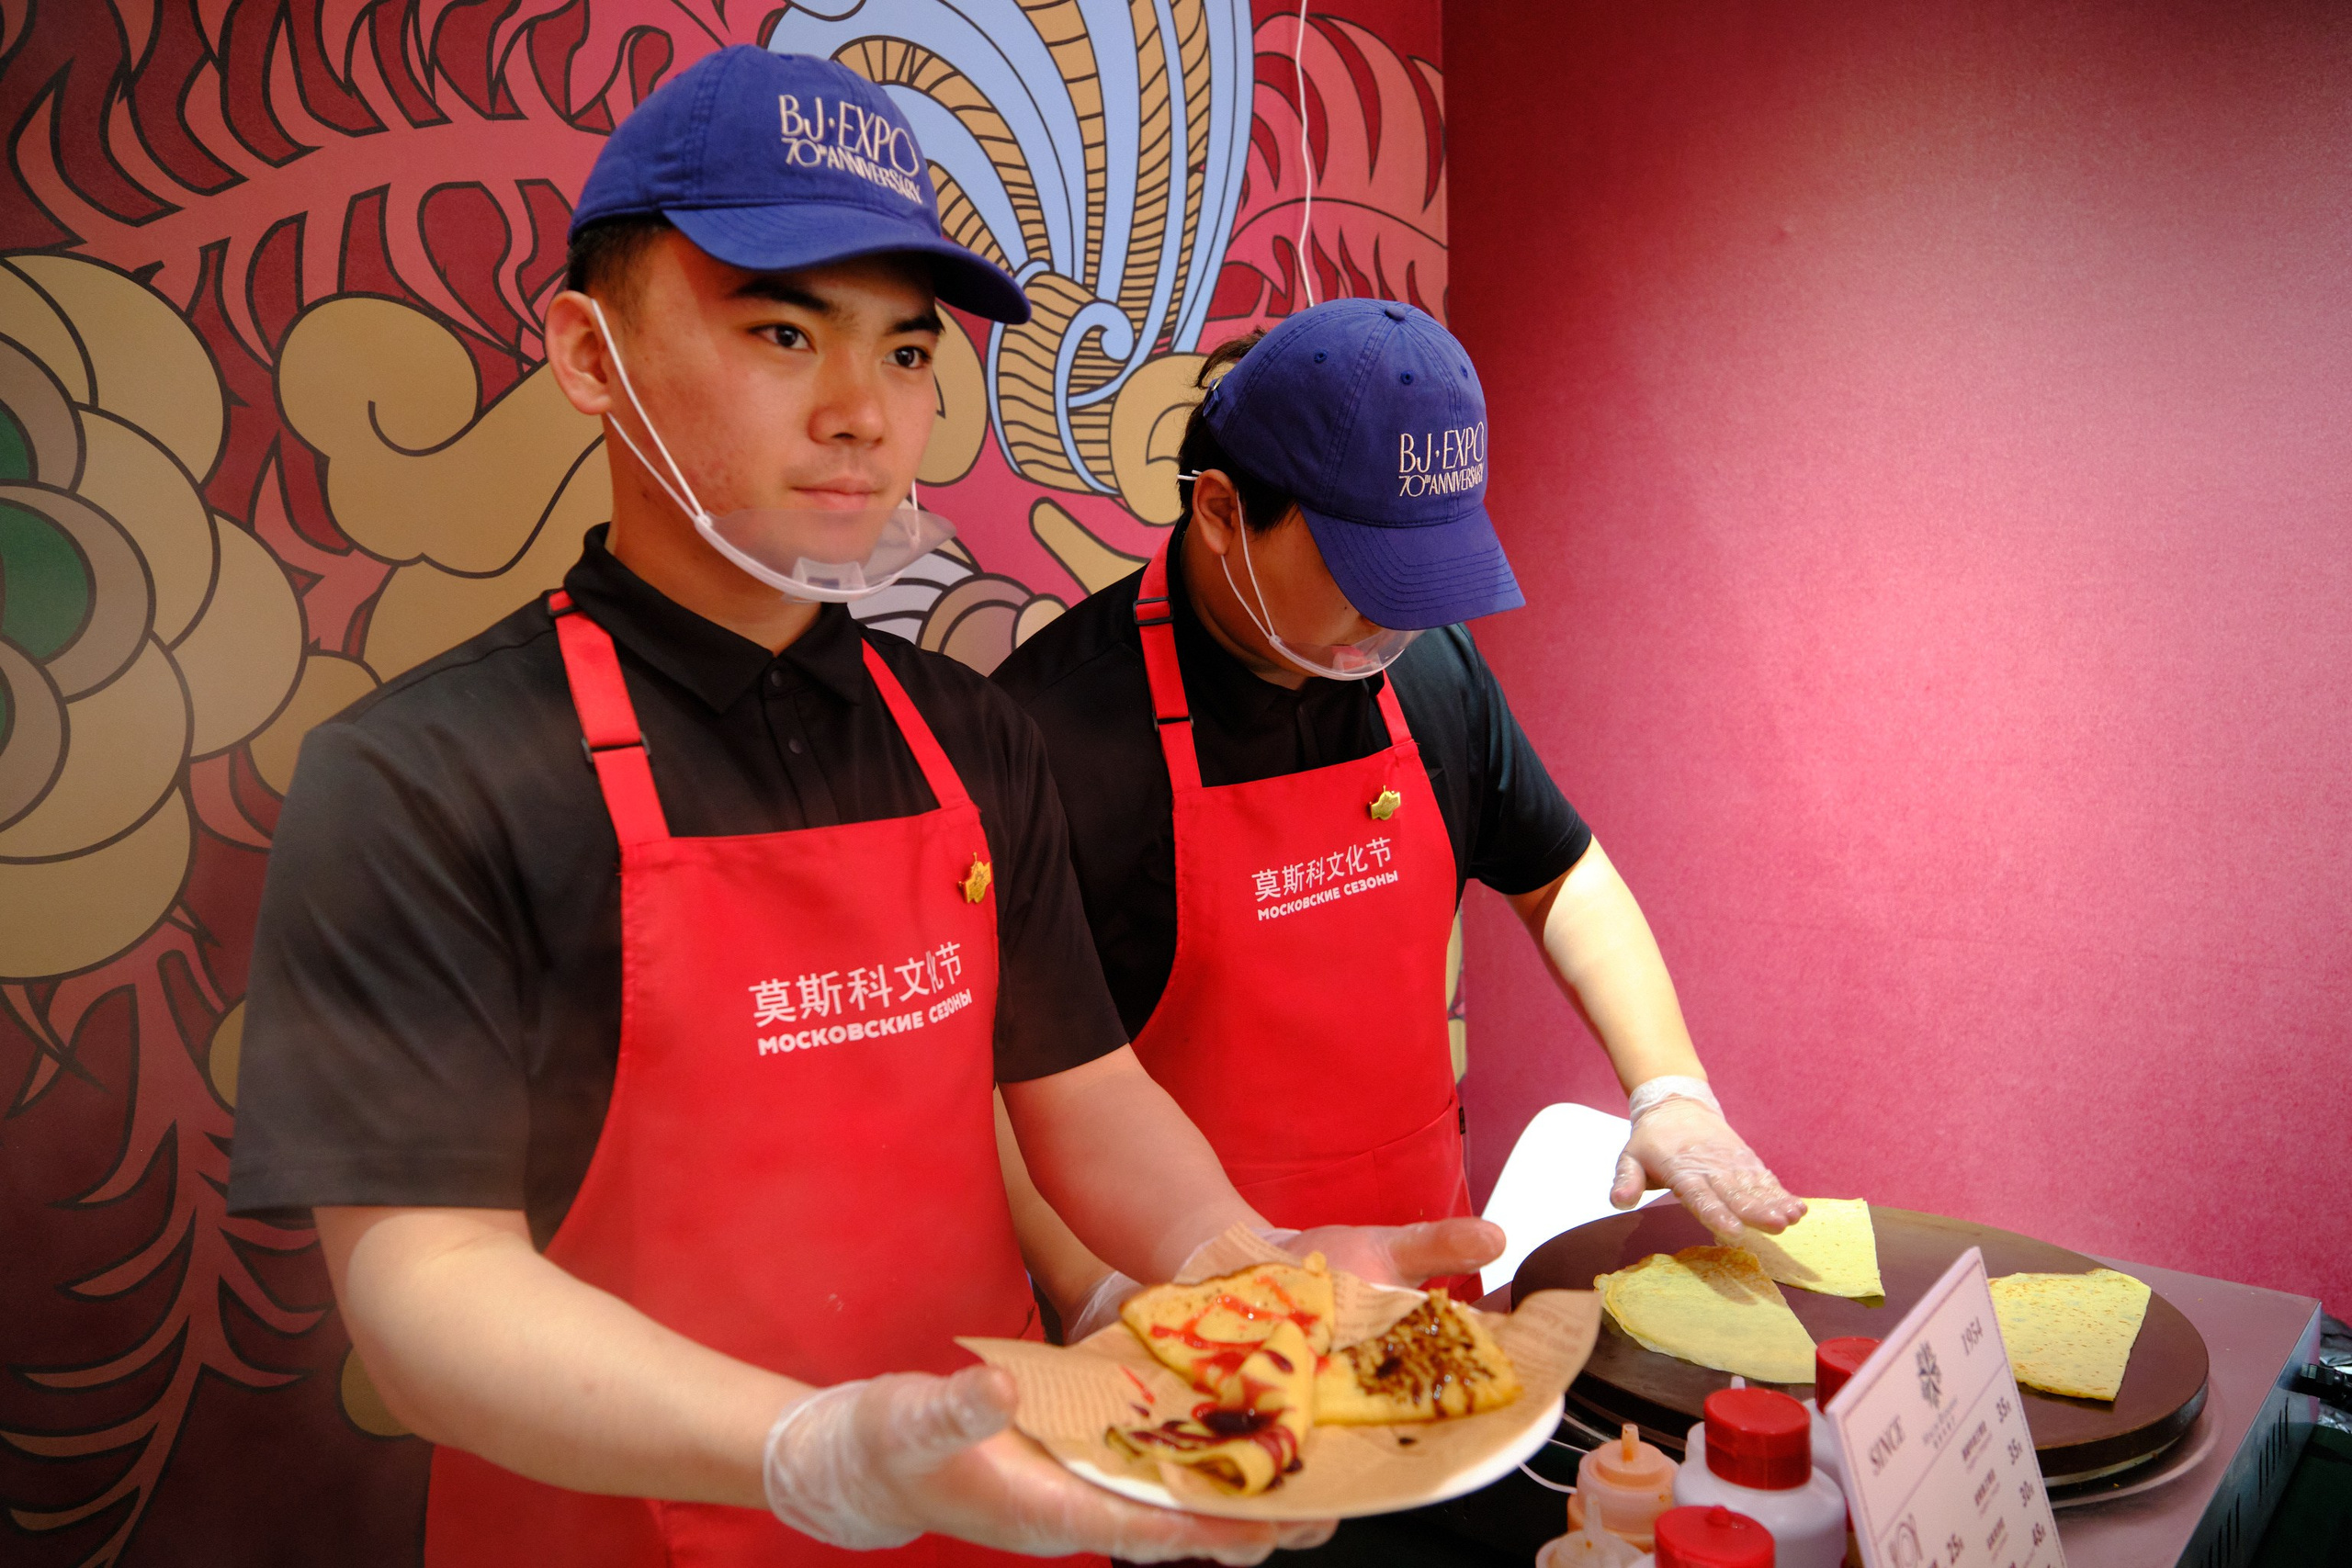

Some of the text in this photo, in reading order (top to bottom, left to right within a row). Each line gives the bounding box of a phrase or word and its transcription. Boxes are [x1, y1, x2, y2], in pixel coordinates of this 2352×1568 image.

[827, 144, 923, 205] ANNIVERSARY
[1429, 462, 1485, 495] ANNIVERSARY
[1251, 837, 1391, 903] 莫斯科文化节
[1257, 870, 1399, 921] МОСКОВСКИЕ СЕЗОНЫ
[748, 941, 962, 1028] 莫斯科文化节
[757, 988, 973, 1056] МОСКОВСКИЕ СЕЗОНЫ
[1867, 1315, 1984, 1477] SINCE 1954
